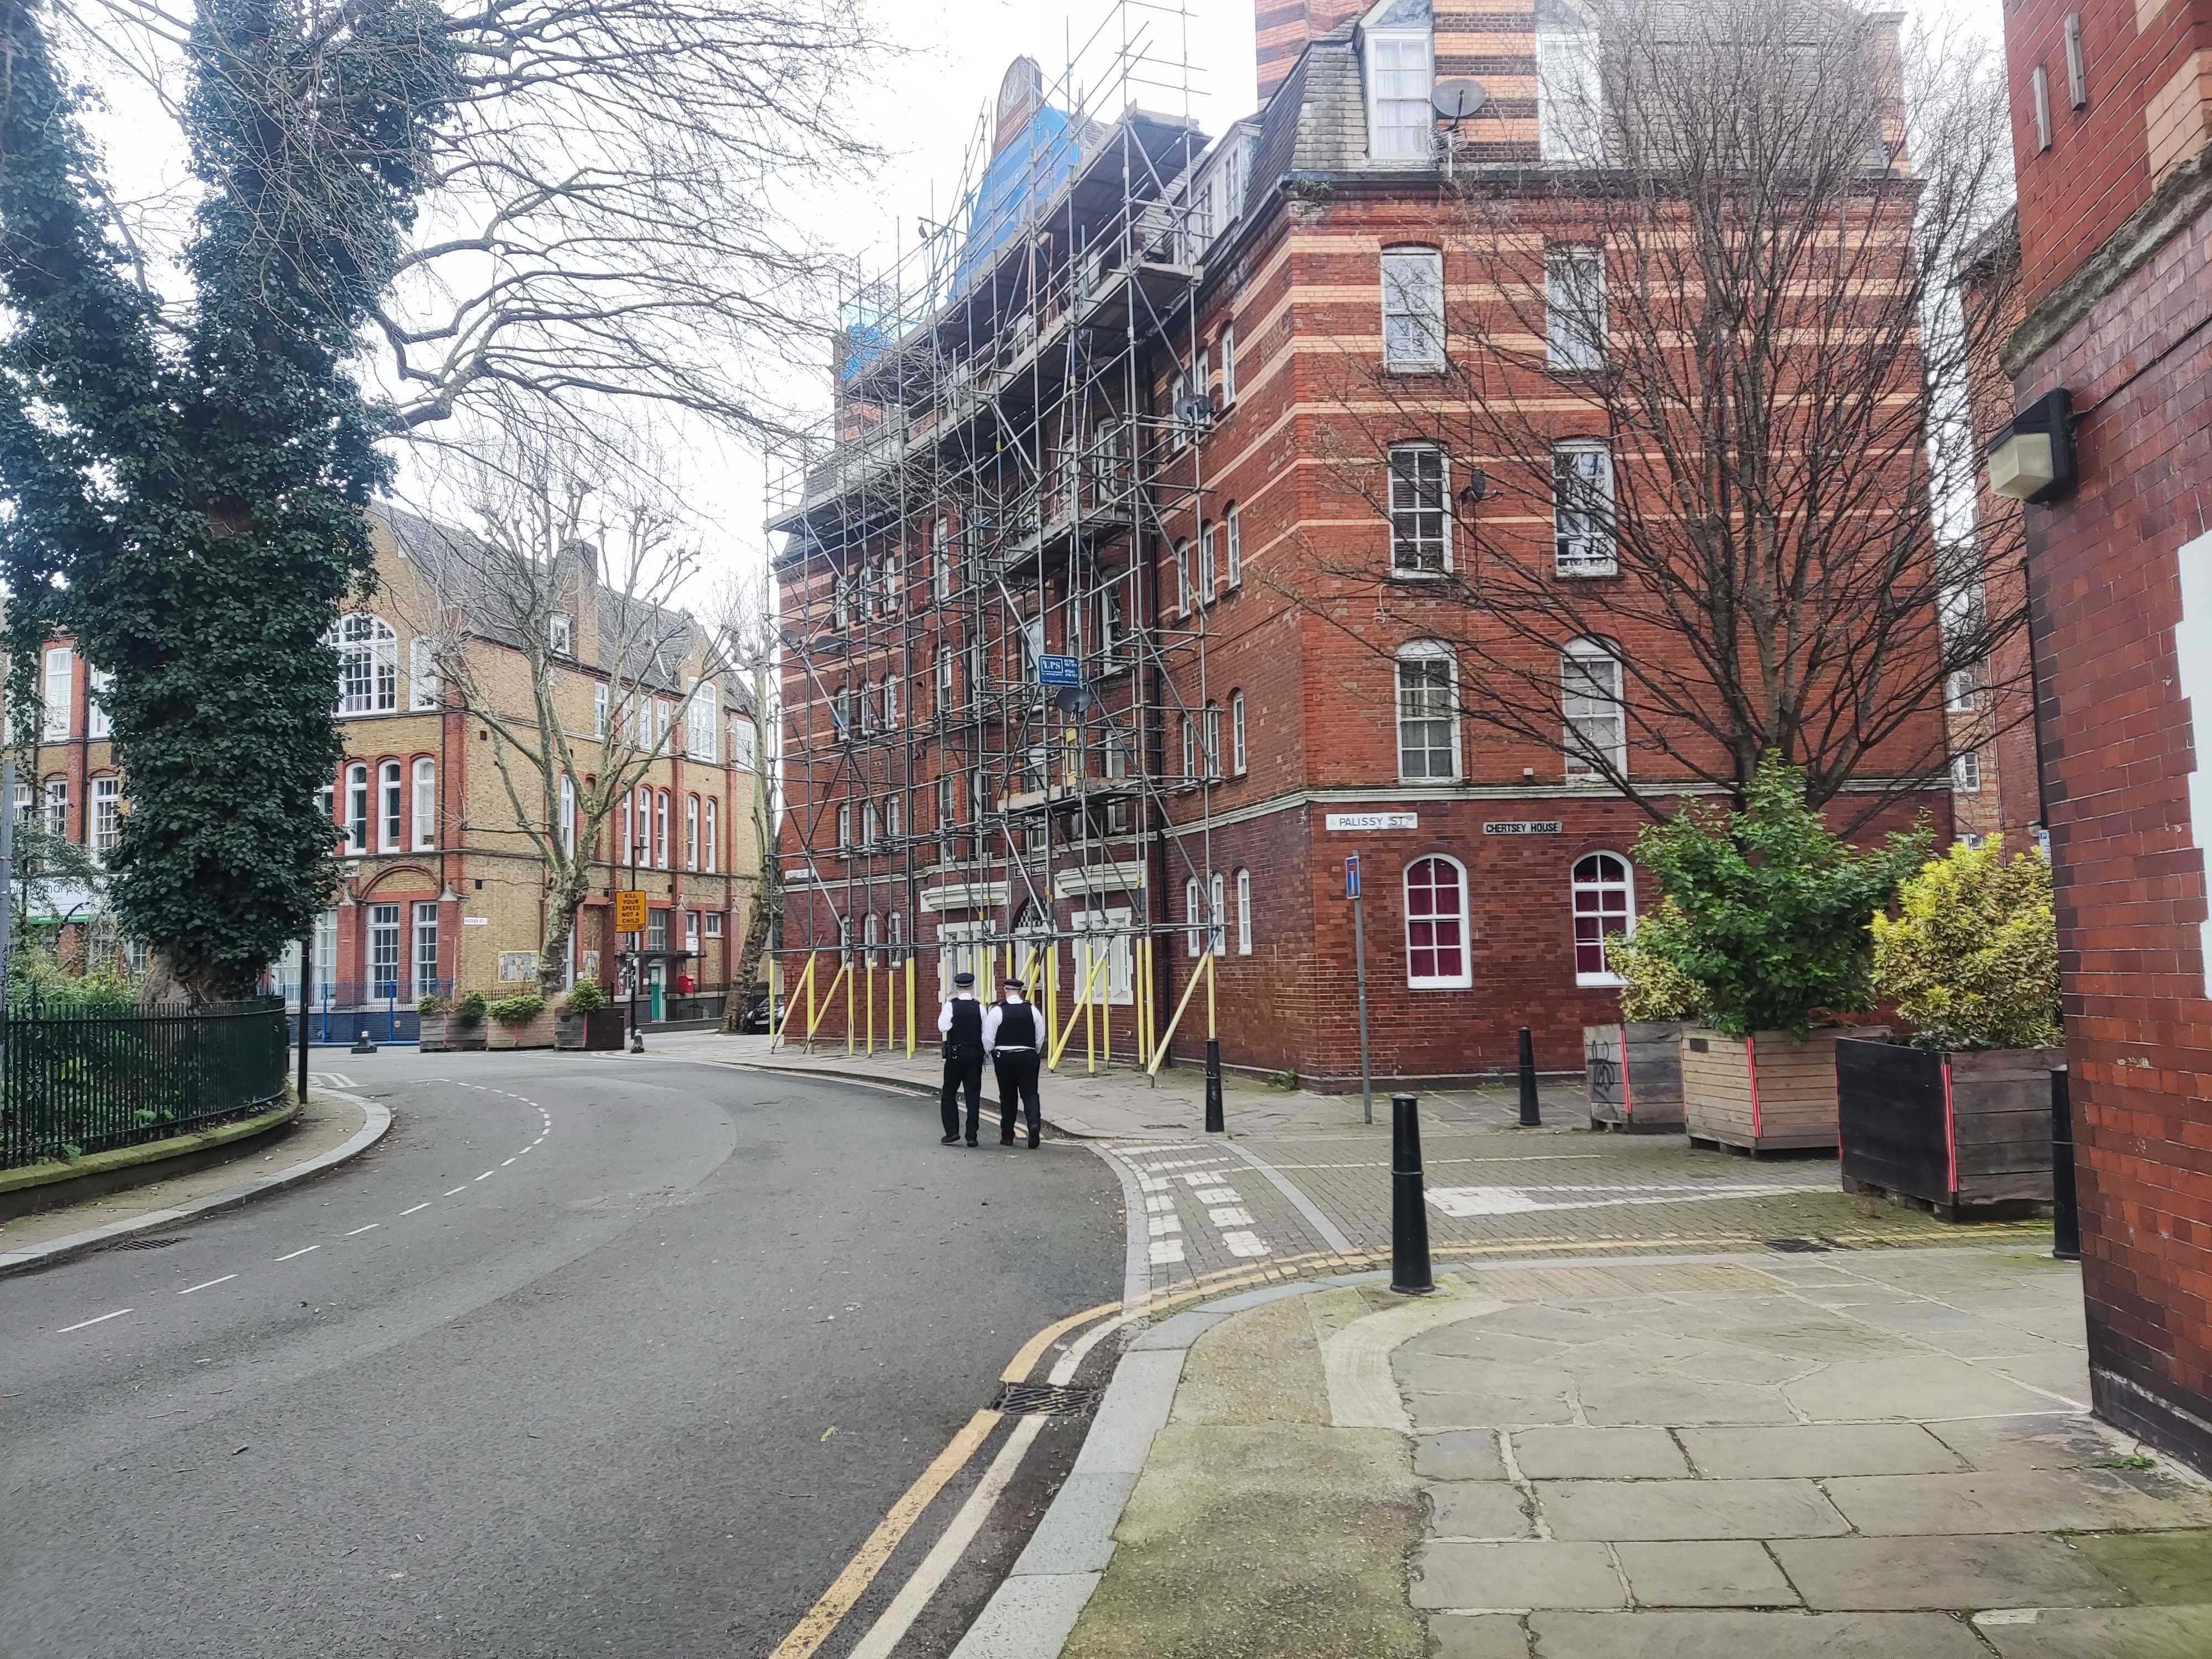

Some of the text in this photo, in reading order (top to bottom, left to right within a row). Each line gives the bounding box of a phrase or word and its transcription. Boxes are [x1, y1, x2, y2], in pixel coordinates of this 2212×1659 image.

[1042, 660, 1061, 669] LPS
[1339, 817, 1383, 826] PALISSY
[1390, 816, 1404, 826] ST
[1486, 823, 1558, 833] CHERTSEY HOUSE
